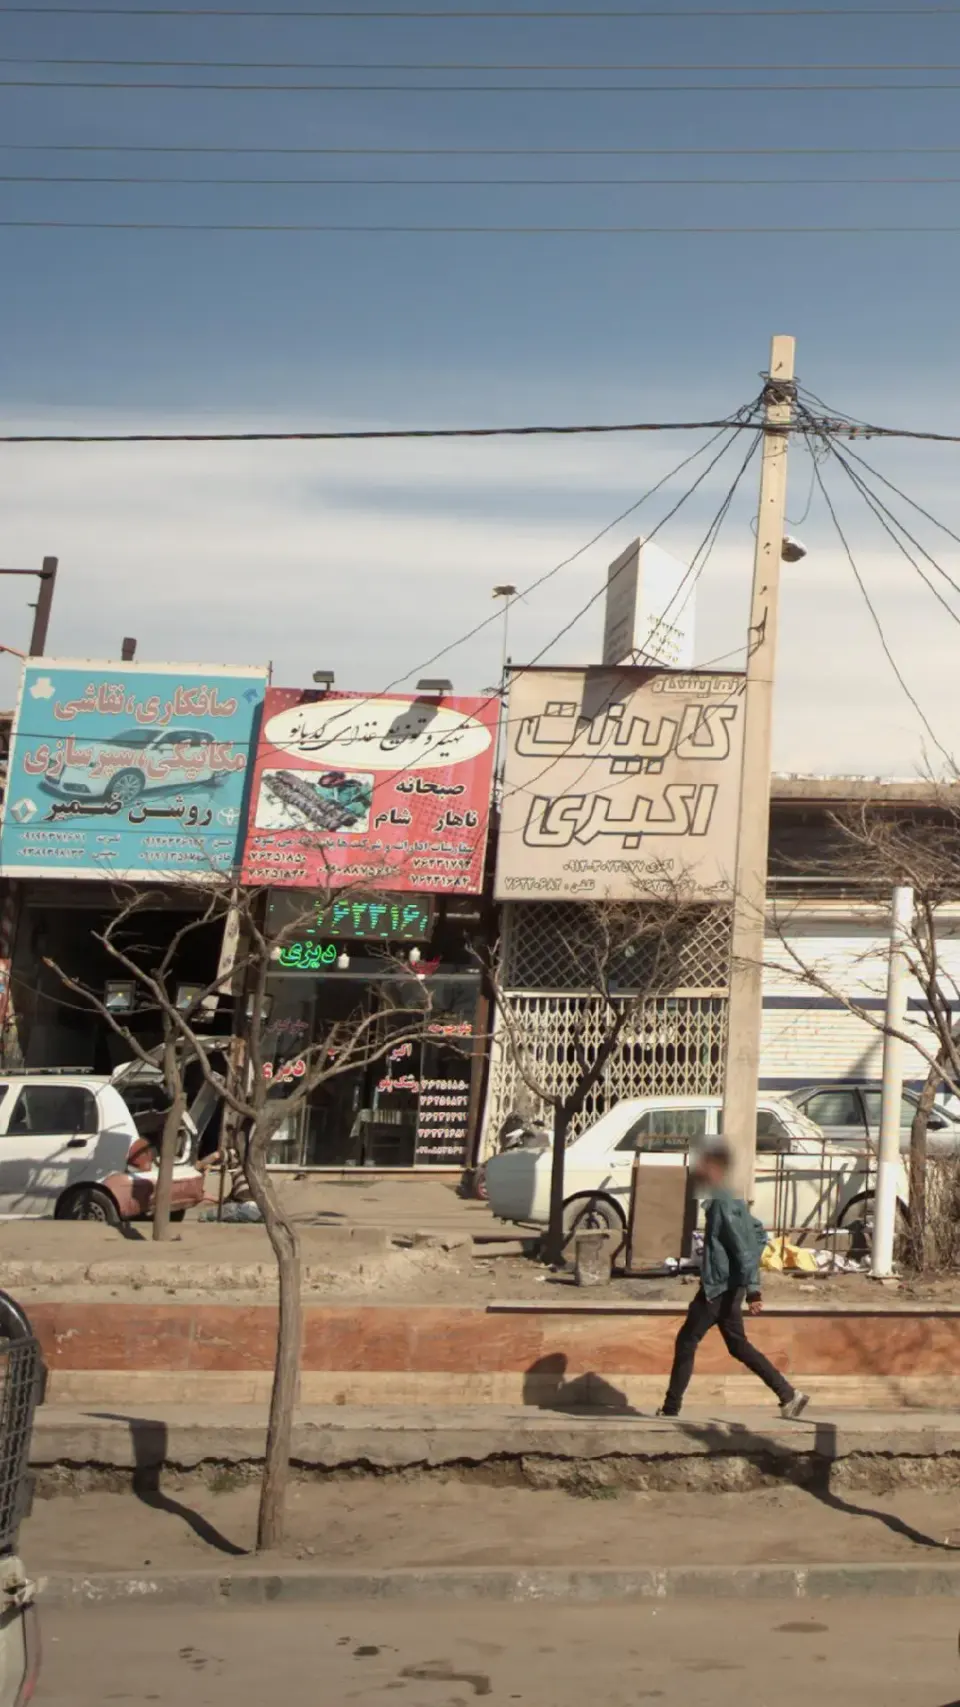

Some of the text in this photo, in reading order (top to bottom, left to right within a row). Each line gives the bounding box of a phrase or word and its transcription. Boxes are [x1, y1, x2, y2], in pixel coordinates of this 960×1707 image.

[652, 676, 740, 698] نمایشگاه
[53, 682, 125, 721] نقاشی
[515, 701, 738, 775] کابینت
[395, 777, 465, 800] صبحانه
[43, 792, 214, 827] روشن ضمیر
[374, 807, 413, 829] شام
[434, 810, 479, 832] ناهار
[523, 783, 719, 850] اکبری
[279, 941, 337, 968] دیزی
